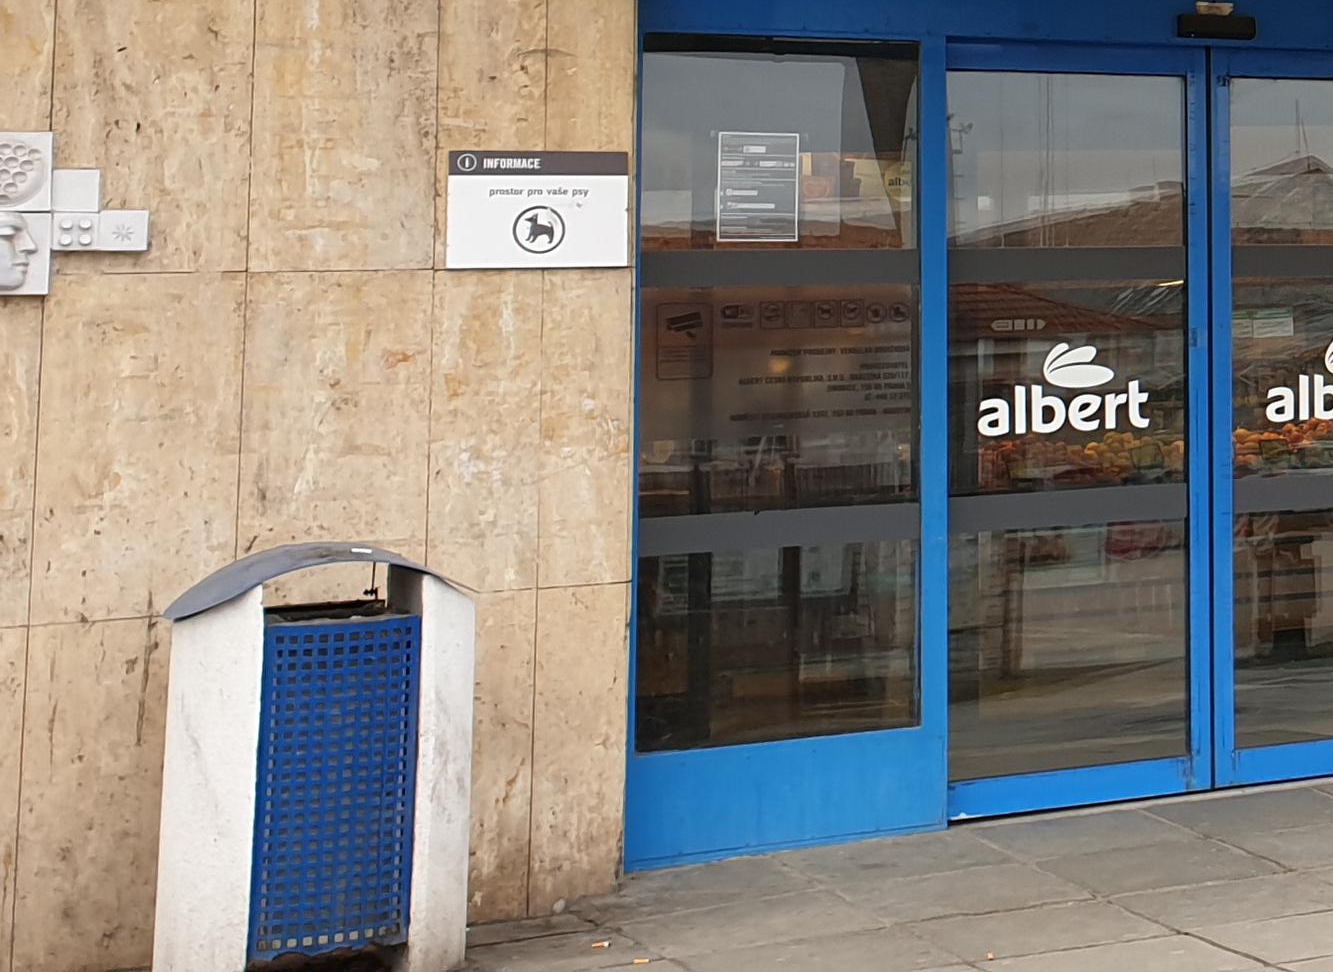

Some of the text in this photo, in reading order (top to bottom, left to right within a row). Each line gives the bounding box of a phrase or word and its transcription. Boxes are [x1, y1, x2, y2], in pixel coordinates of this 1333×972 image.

[483, 158, 542, 170] INFORMACE
[489, 187, 589, 198] prostor pro vaše psy
[977, 379, 1150, 437] albert
